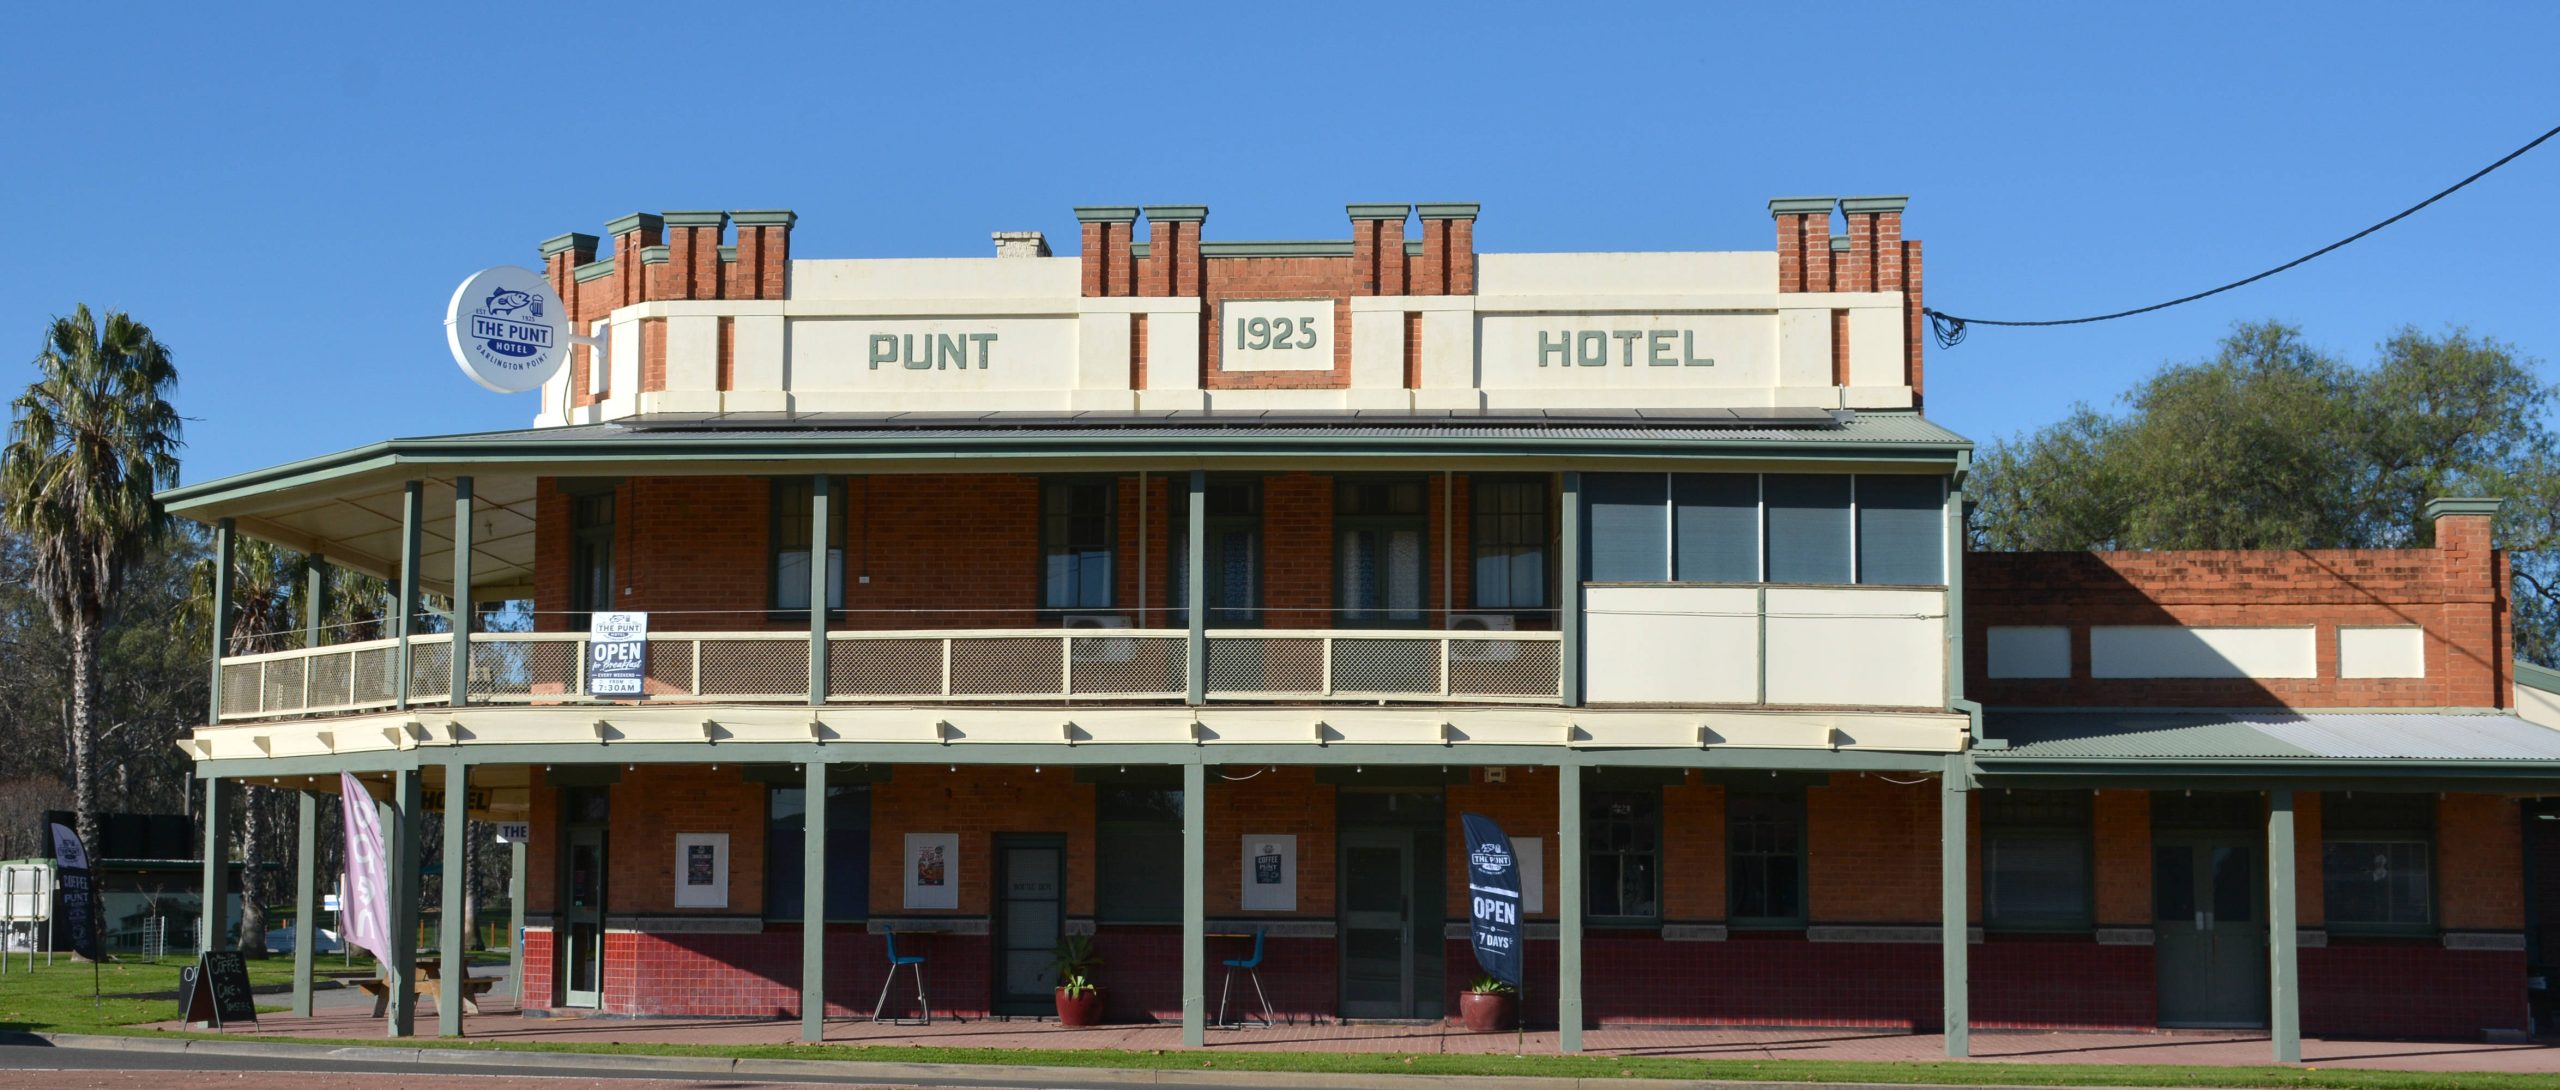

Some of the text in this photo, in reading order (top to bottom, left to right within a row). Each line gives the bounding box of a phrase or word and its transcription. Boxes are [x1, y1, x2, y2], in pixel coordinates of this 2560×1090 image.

[477, 320, 548, 343] THE PUNT
[1237, 317, 1317, 350] 1925
[476, 344, 548, 370] DARLINGTON POINT
[496, 342, 527, 354] HOTEL
[869, 333, 998, 370] PUNT
[1538, 329, 1715, 367] HOTEL
[594, 642, 641, 661] OPEN
[592, 659, 642, 671] for Breakfast
[421, 791, 487, 810] HOEL
[503, 826, 527, 838] THE
[1258, 856, 1278, 864] COFFEE
[1473, 896, 1515, 926] OPEN
[1479, 932, 1509, 948] 7 DAYS
